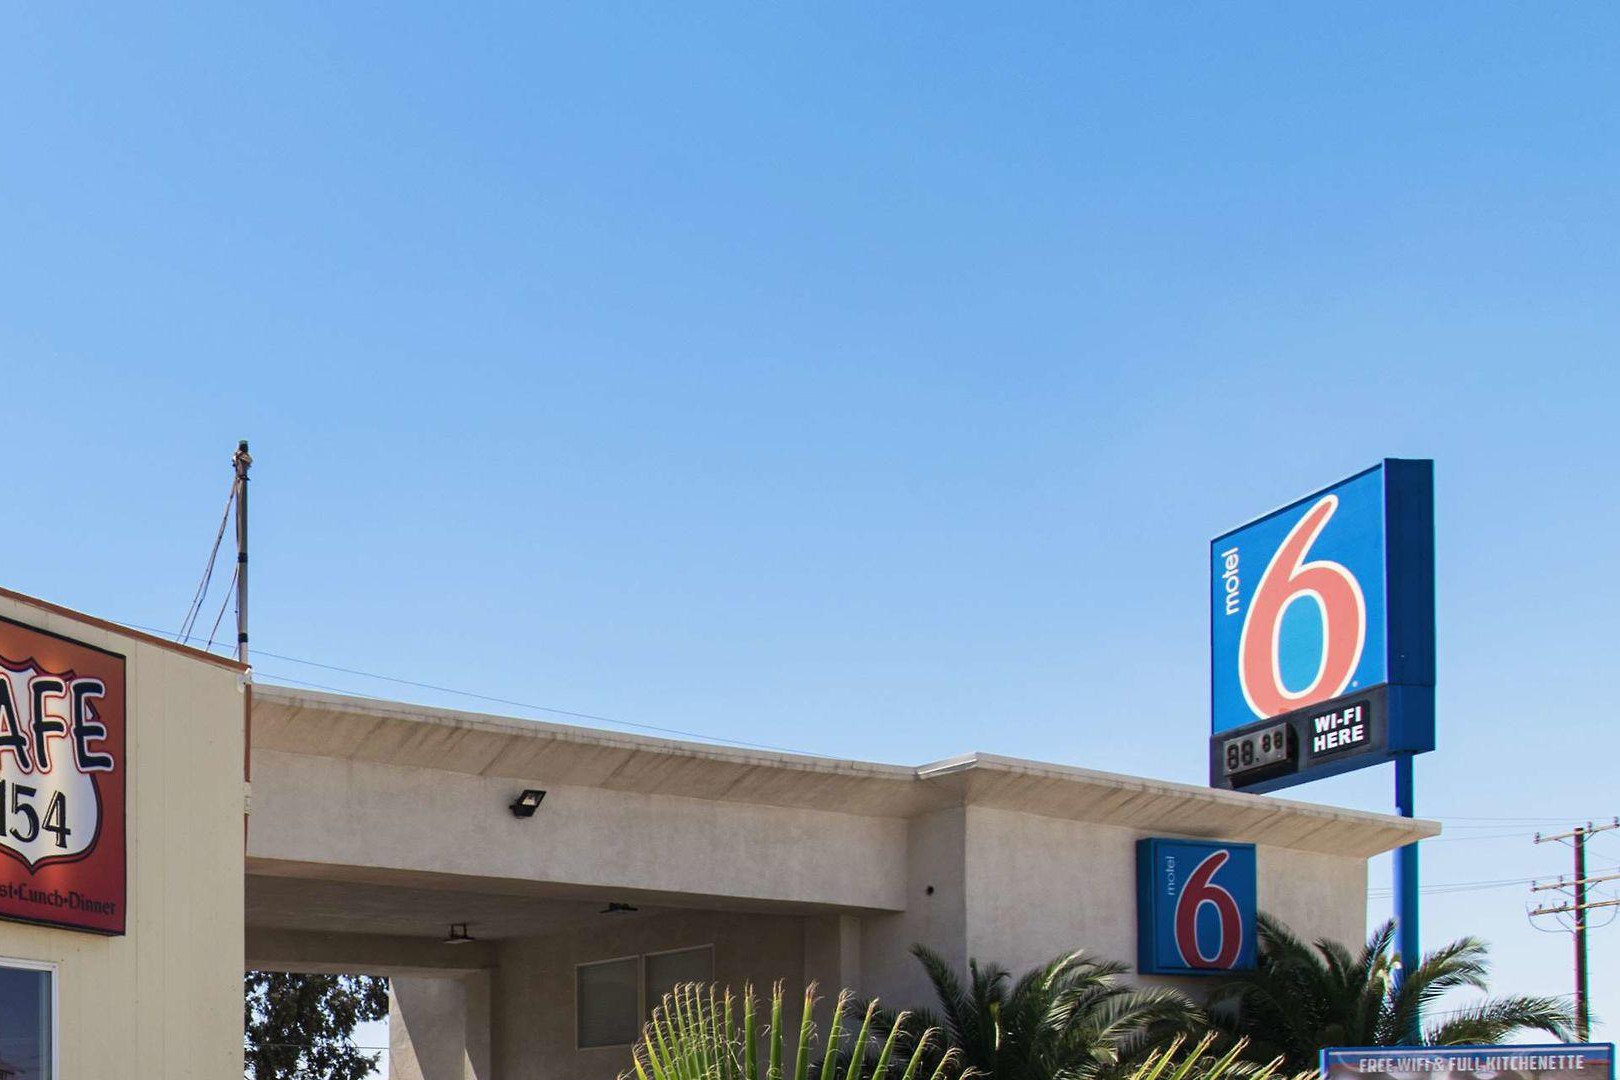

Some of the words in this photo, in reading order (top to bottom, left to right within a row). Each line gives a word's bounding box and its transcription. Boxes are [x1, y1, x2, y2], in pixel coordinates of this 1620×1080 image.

[1221, 547, 1239, 616] motel
[1238, 494, 1366, 719] 6
[1313, 724, 1365, 753] HERE
[1314, 706, 1362, 734] WI-FI
[1165, 855, 1176, 896] motel
[1174, 849, 1243, 970] 6
[1359, 1058, 1393, 1073] FREE
[1432, 1056, 1446, 1072] &
[1449, 1056, 1481, 1072] FULL
[1484, 1054, 1585, 1071] KITCHENETTE
